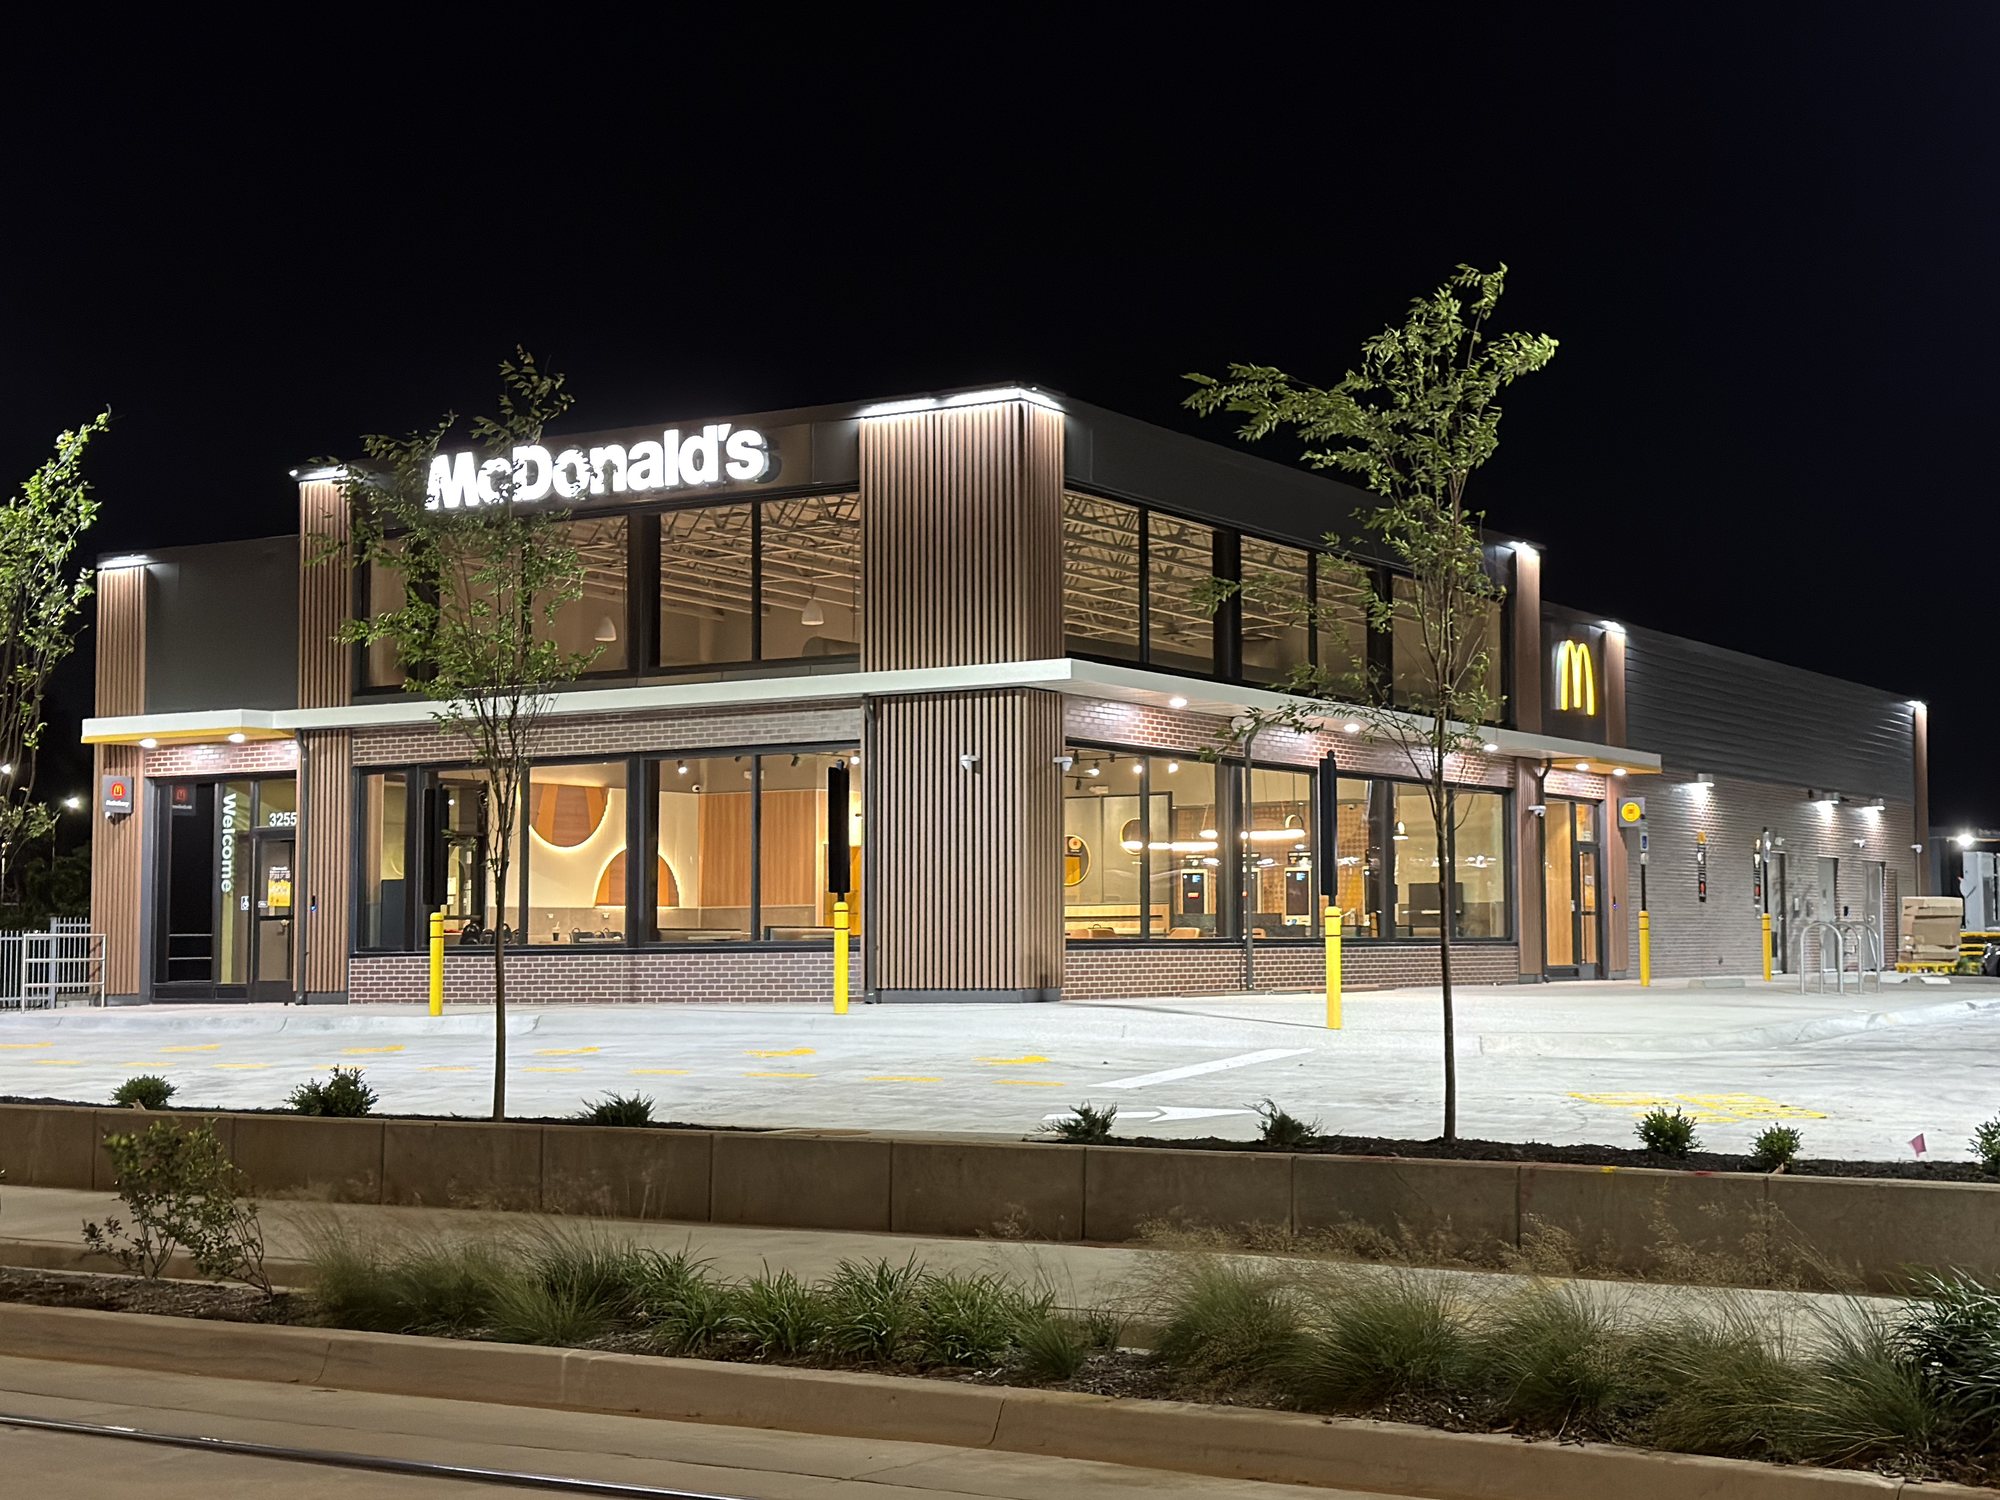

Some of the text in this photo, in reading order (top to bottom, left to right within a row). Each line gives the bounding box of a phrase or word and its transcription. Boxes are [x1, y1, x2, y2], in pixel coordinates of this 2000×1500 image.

[425, 424, 766, 510] McDonald's
[221, 793, 237, 893] Welcome
[269, 811, 297, 827] 3255
